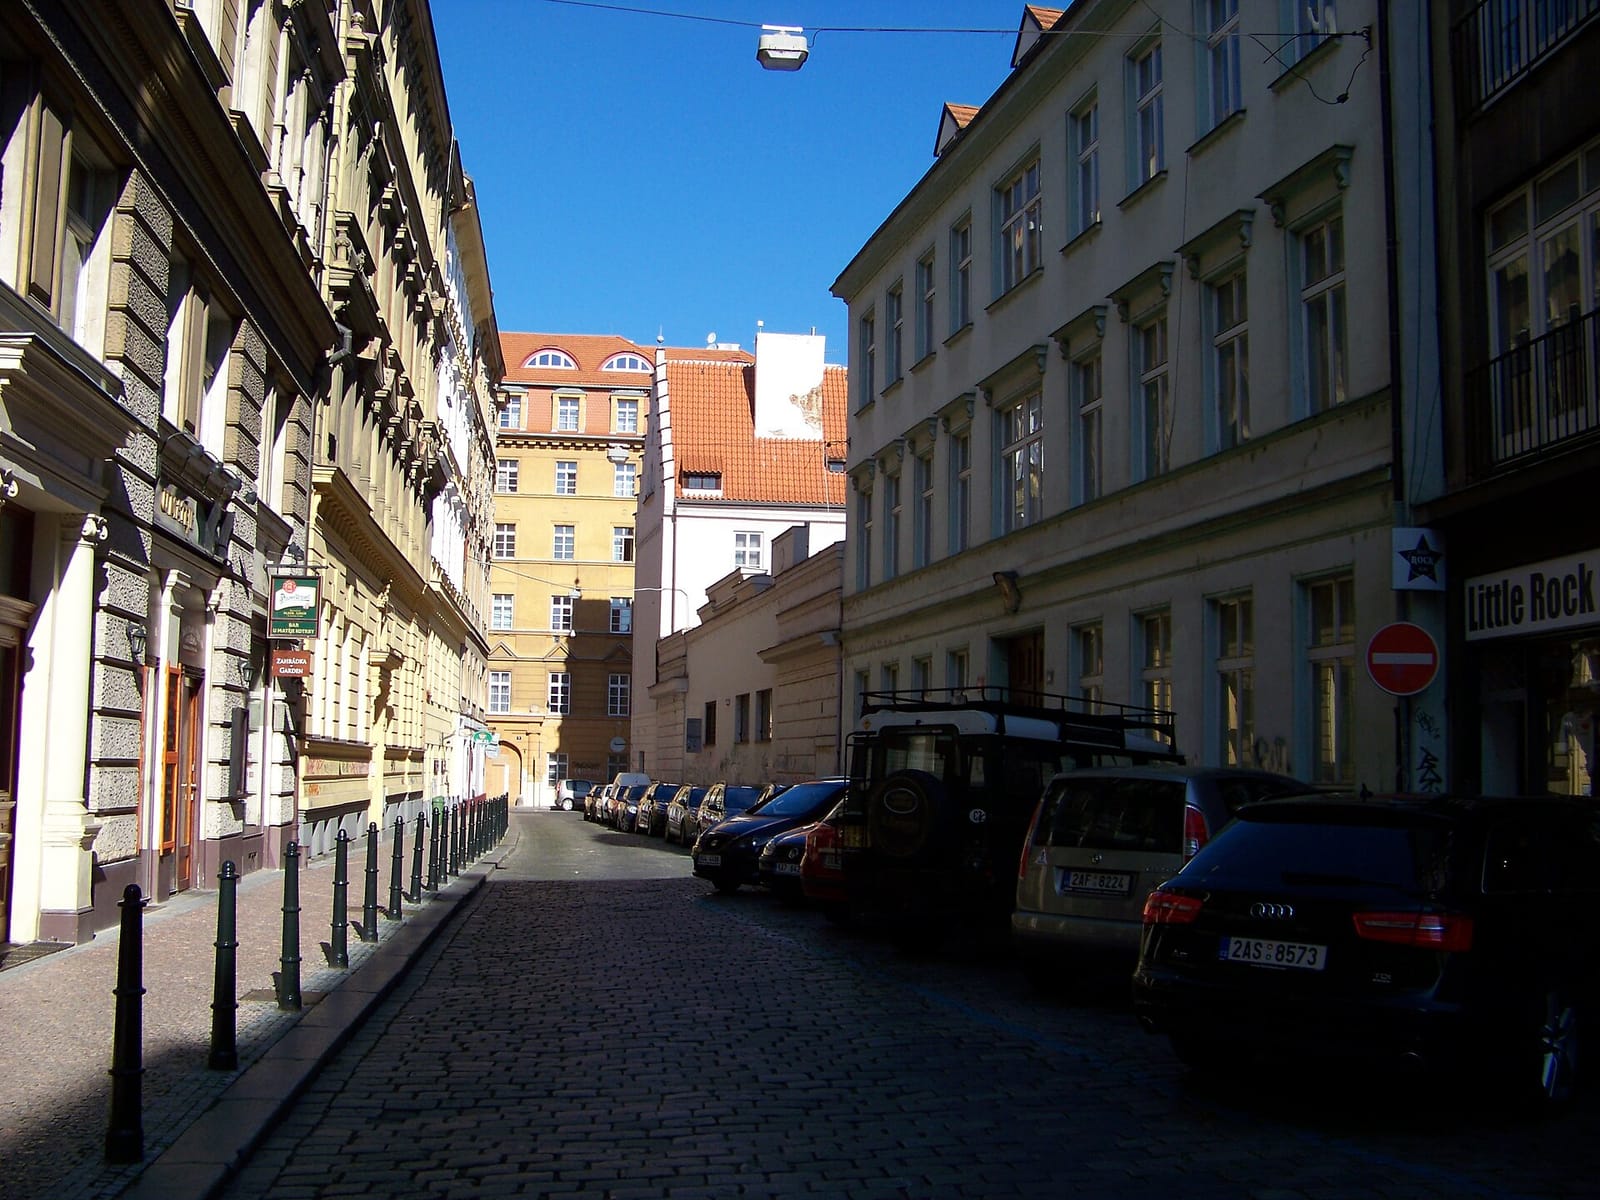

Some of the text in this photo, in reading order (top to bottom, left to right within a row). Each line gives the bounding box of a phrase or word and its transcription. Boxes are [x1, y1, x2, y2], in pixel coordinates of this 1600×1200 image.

[1468, 563, 1594, 632] Little Rock
[1231, 940, 1318, 965] 2AS 8573
